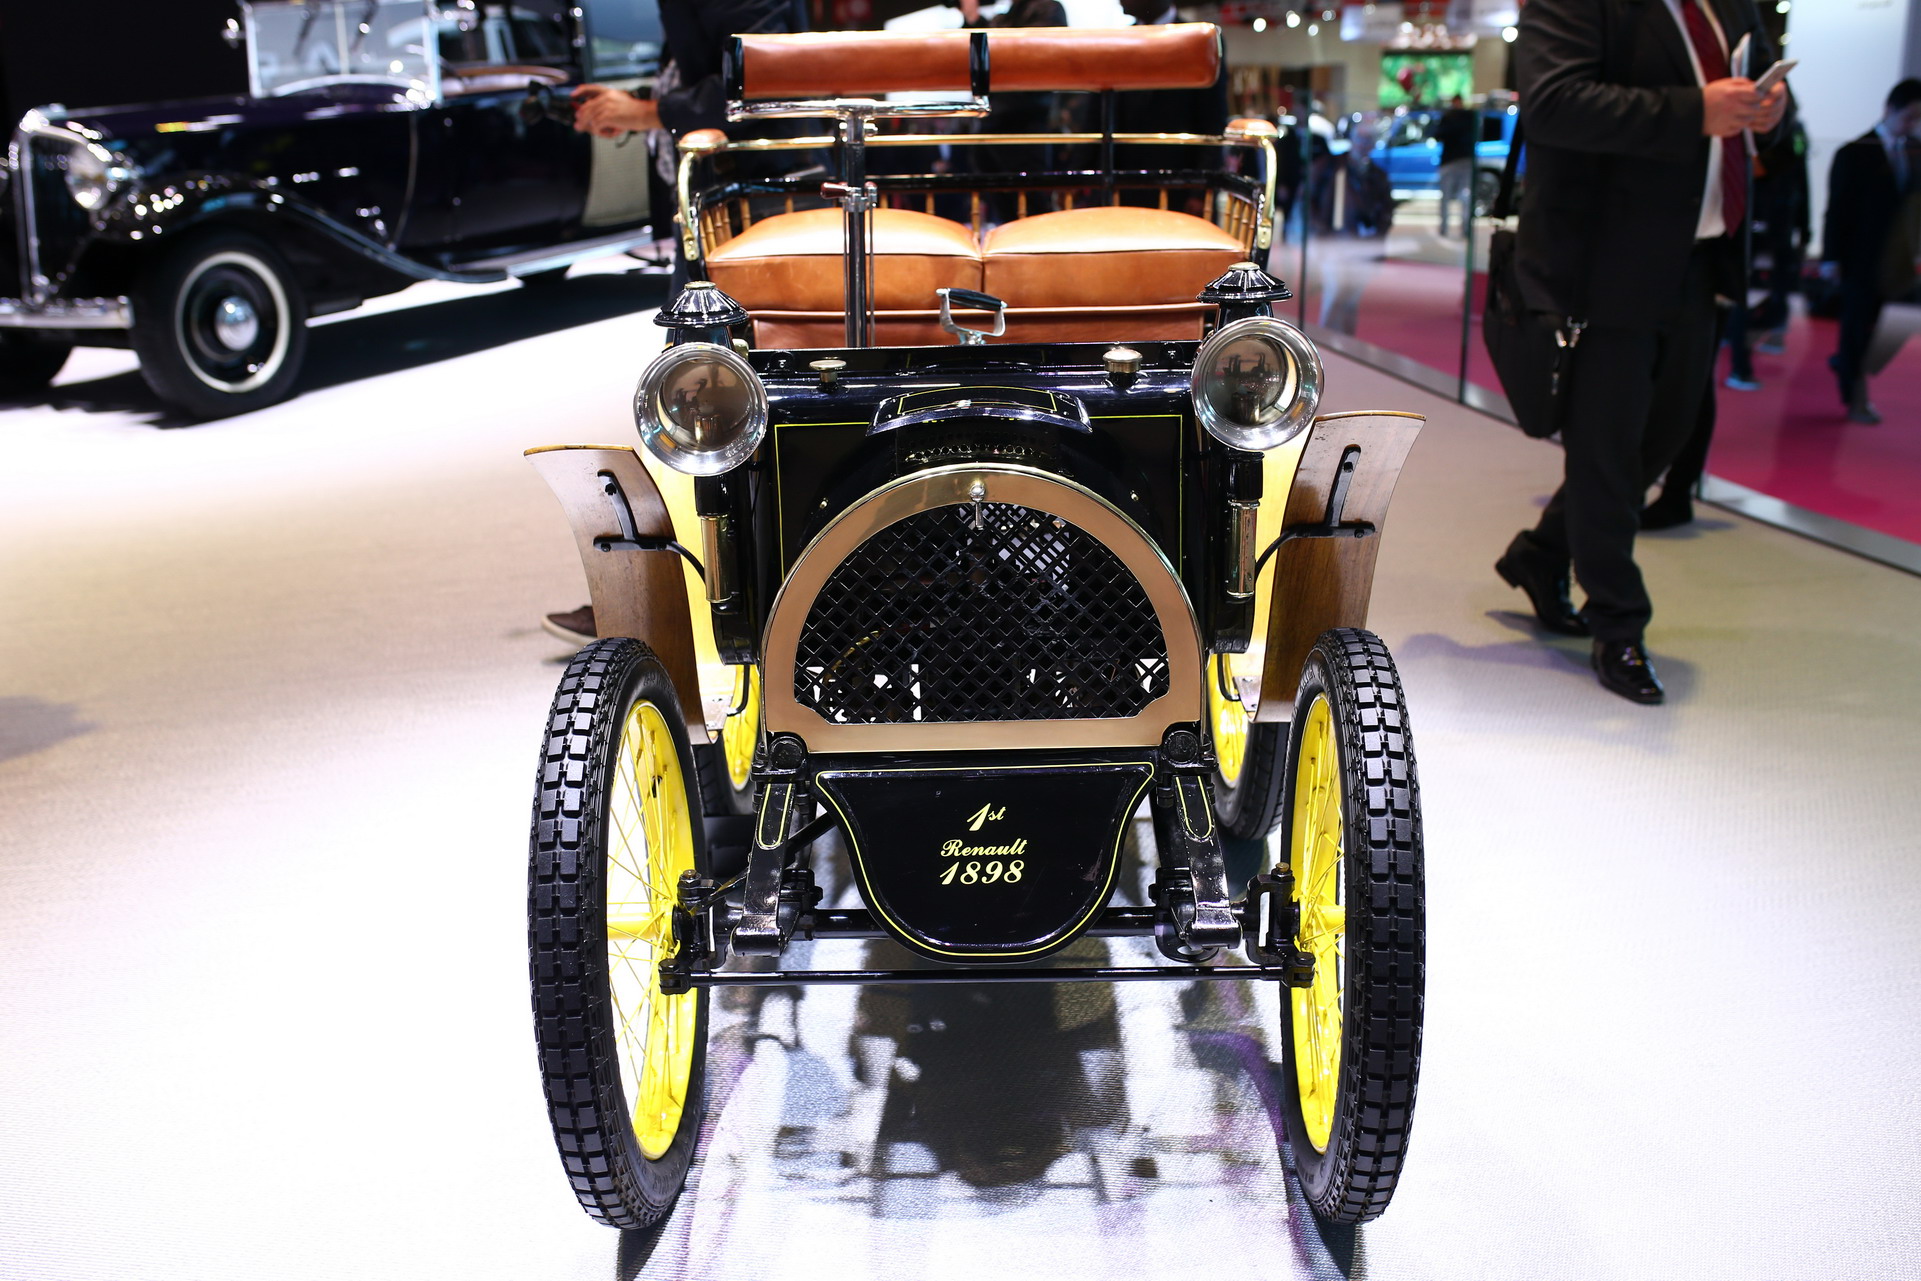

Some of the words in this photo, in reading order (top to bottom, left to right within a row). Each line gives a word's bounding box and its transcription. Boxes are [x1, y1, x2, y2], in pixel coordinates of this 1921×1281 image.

[966, 802, 1007, 832] 1st
[940, 837, 1028, 858] Renault
[939, 859, 1025, 886] 1898
